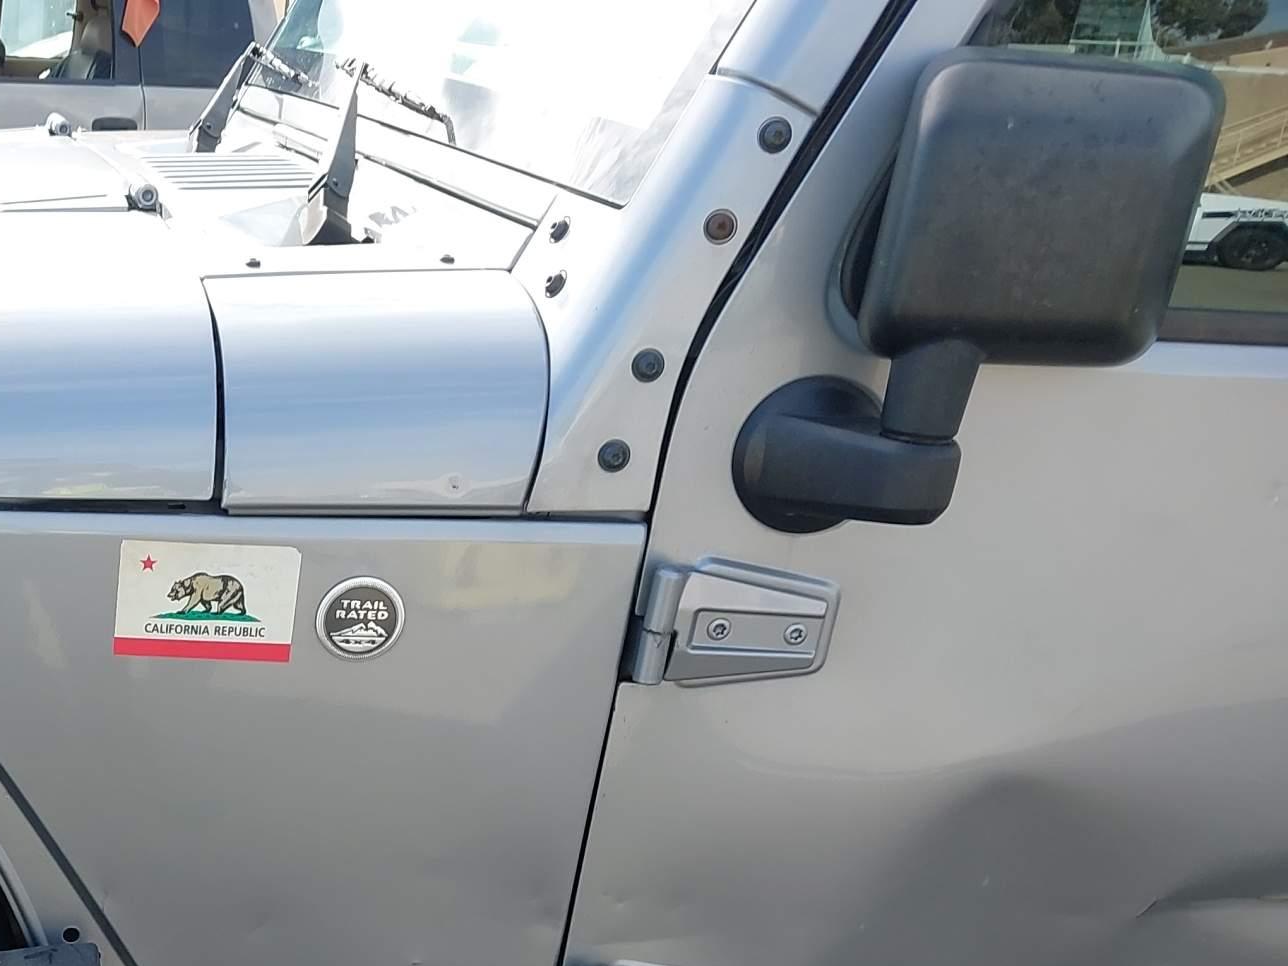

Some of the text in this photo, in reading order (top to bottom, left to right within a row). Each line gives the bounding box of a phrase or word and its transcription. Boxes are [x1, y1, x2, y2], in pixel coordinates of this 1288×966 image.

[341, 600, 388, 610] TRAIL
[335, 610, 389, 620] RATED
[144, 622, 266, 638] CALIFORNIA REPUBLIC
